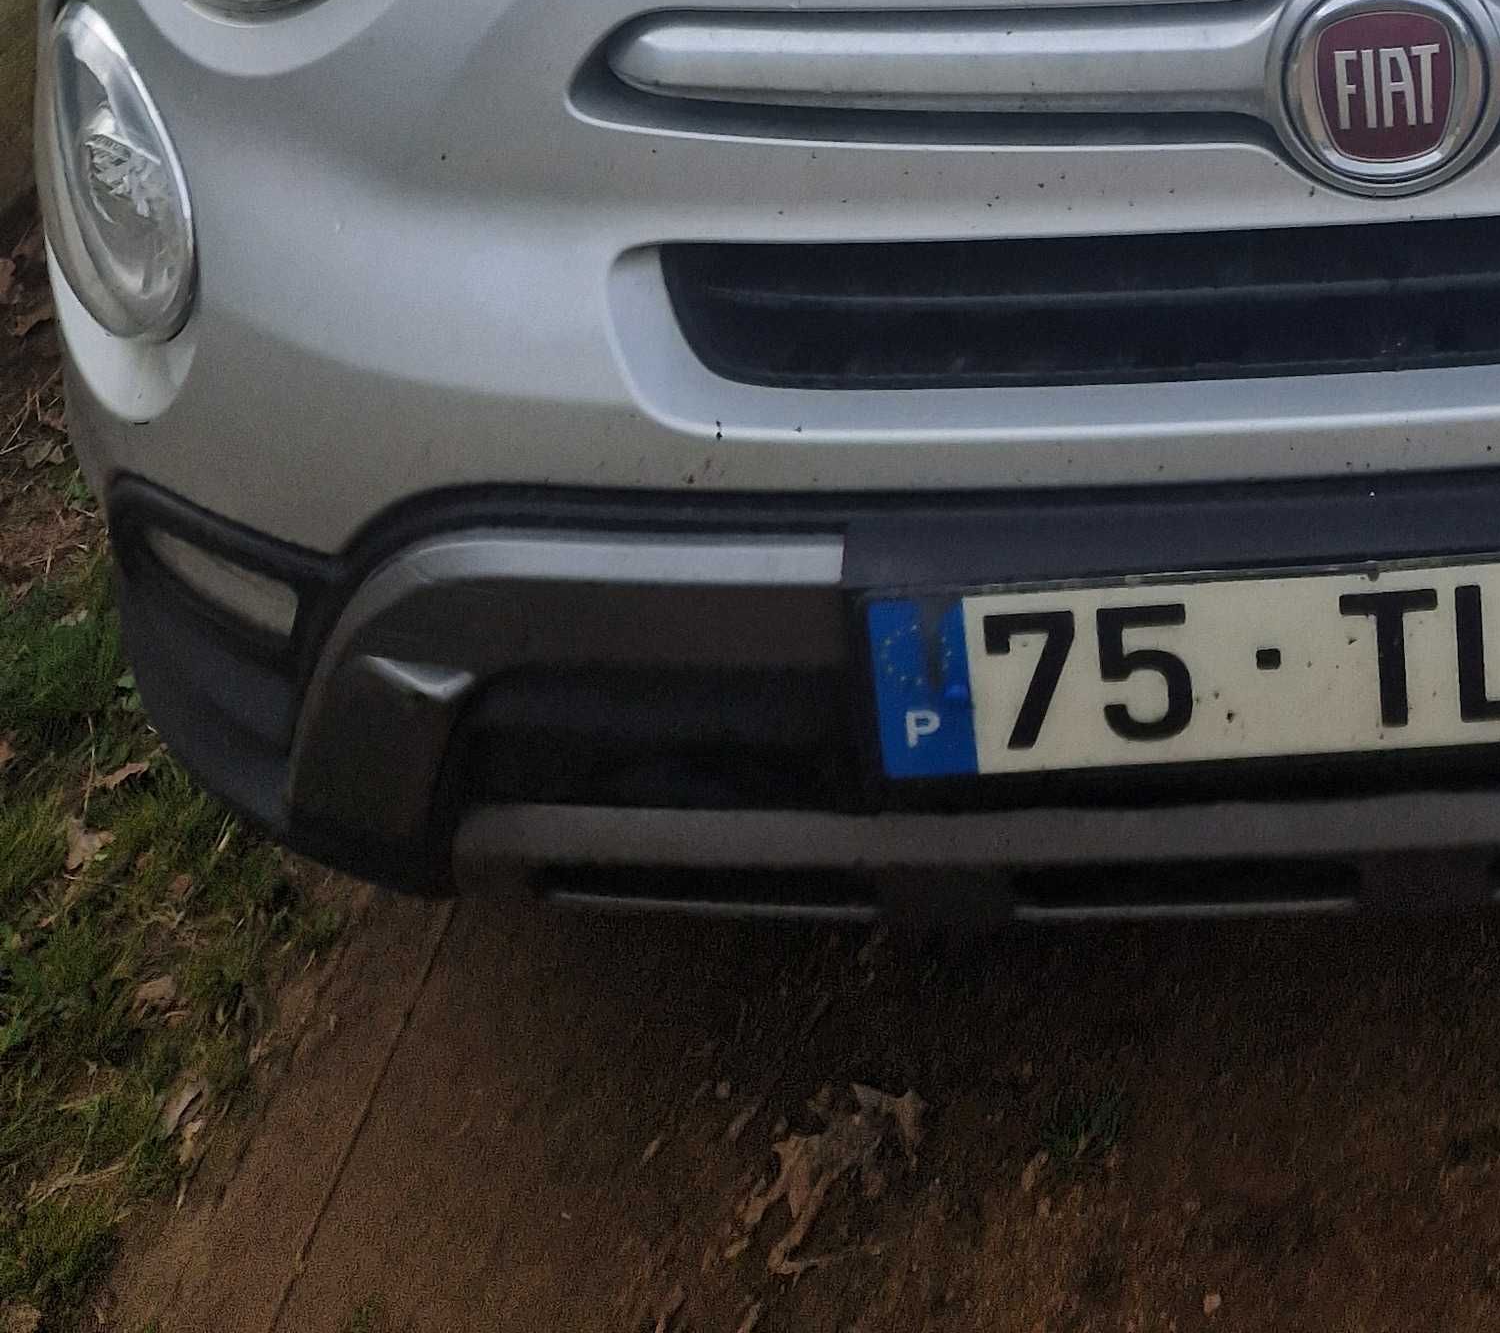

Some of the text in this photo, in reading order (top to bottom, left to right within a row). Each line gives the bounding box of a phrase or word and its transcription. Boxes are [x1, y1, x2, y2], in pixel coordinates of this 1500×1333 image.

[1333, 42, 1441, 130] FIAT
[905, 708, 941, 748] P
[983, 602, 1193, 750] 75
